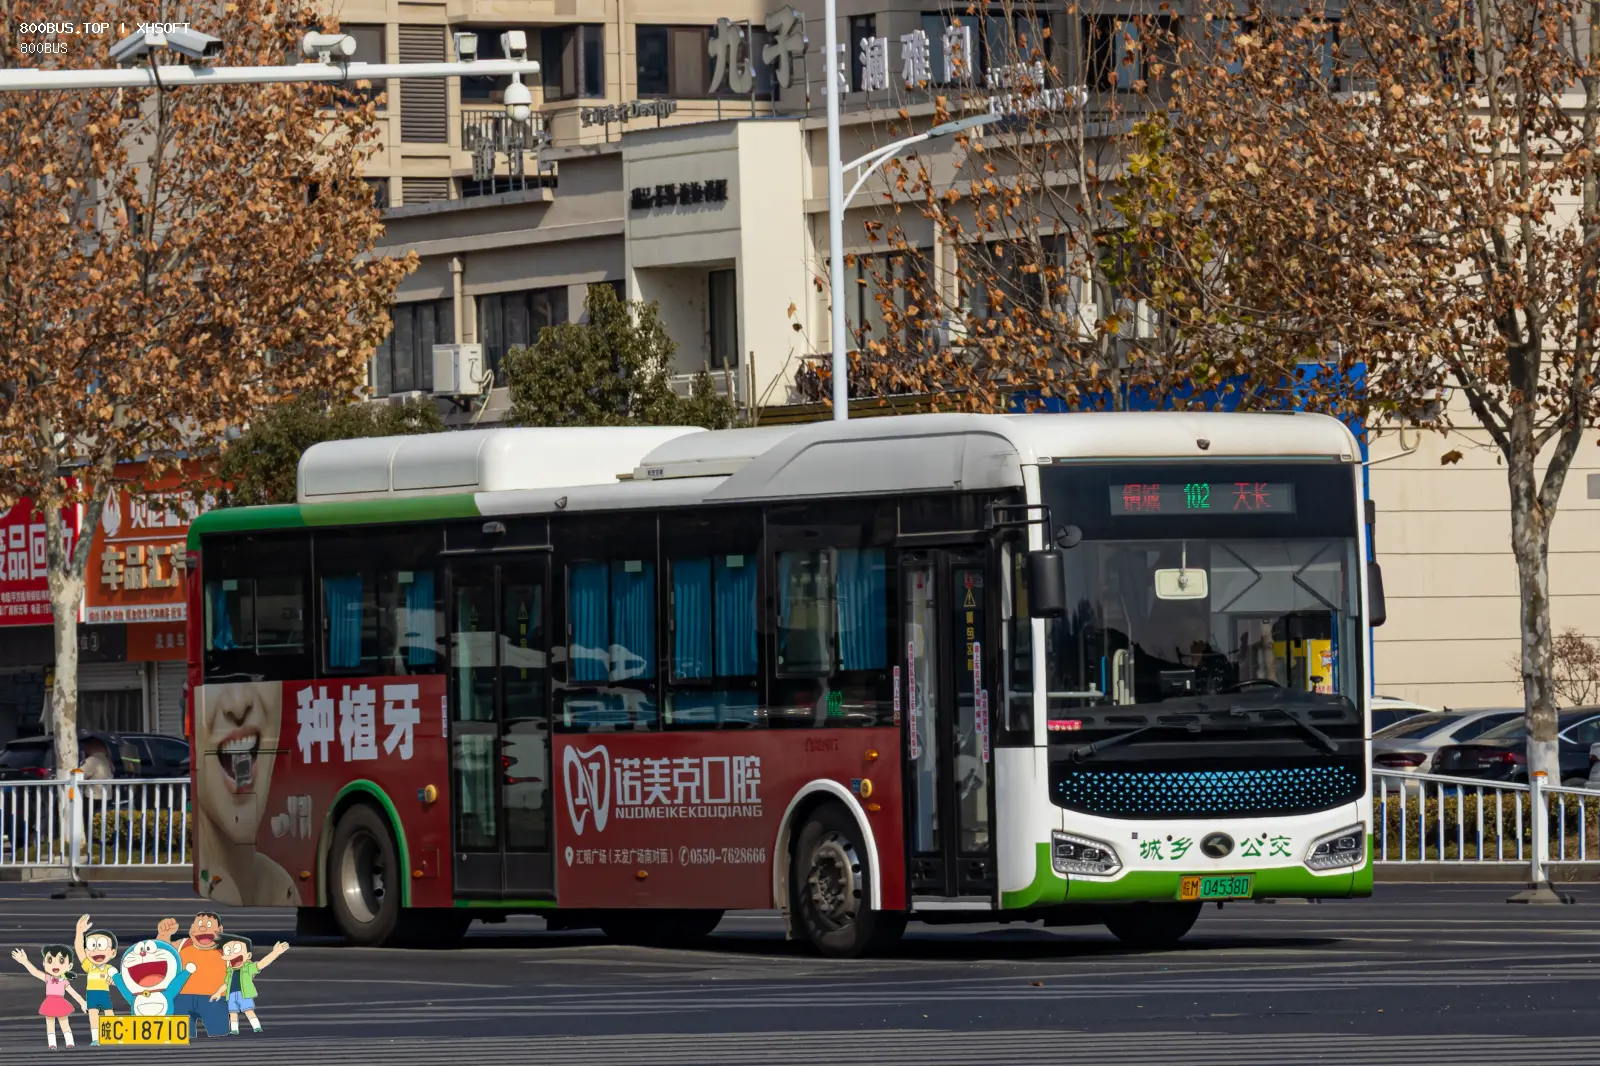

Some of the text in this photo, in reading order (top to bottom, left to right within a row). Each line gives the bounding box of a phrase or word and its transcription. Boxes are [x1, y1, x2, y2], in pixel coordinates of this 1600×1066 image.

[630, 98, 678, 118] Design
[1184, 483, 1210, 509] 102
[1232, 482, 1271, 510] 天长
[825, 690, 843, 716] 102
[296, 684, 420, 764] 种植牙
[614, 755, 762, 805] 诺美克口腔
[615, 805, 763, 819] NUOMEIKEKOUQIANG
[690, 847, 766, 865] 0550-7628666
[1140, 835, 1292, 861] 城乡 公交
